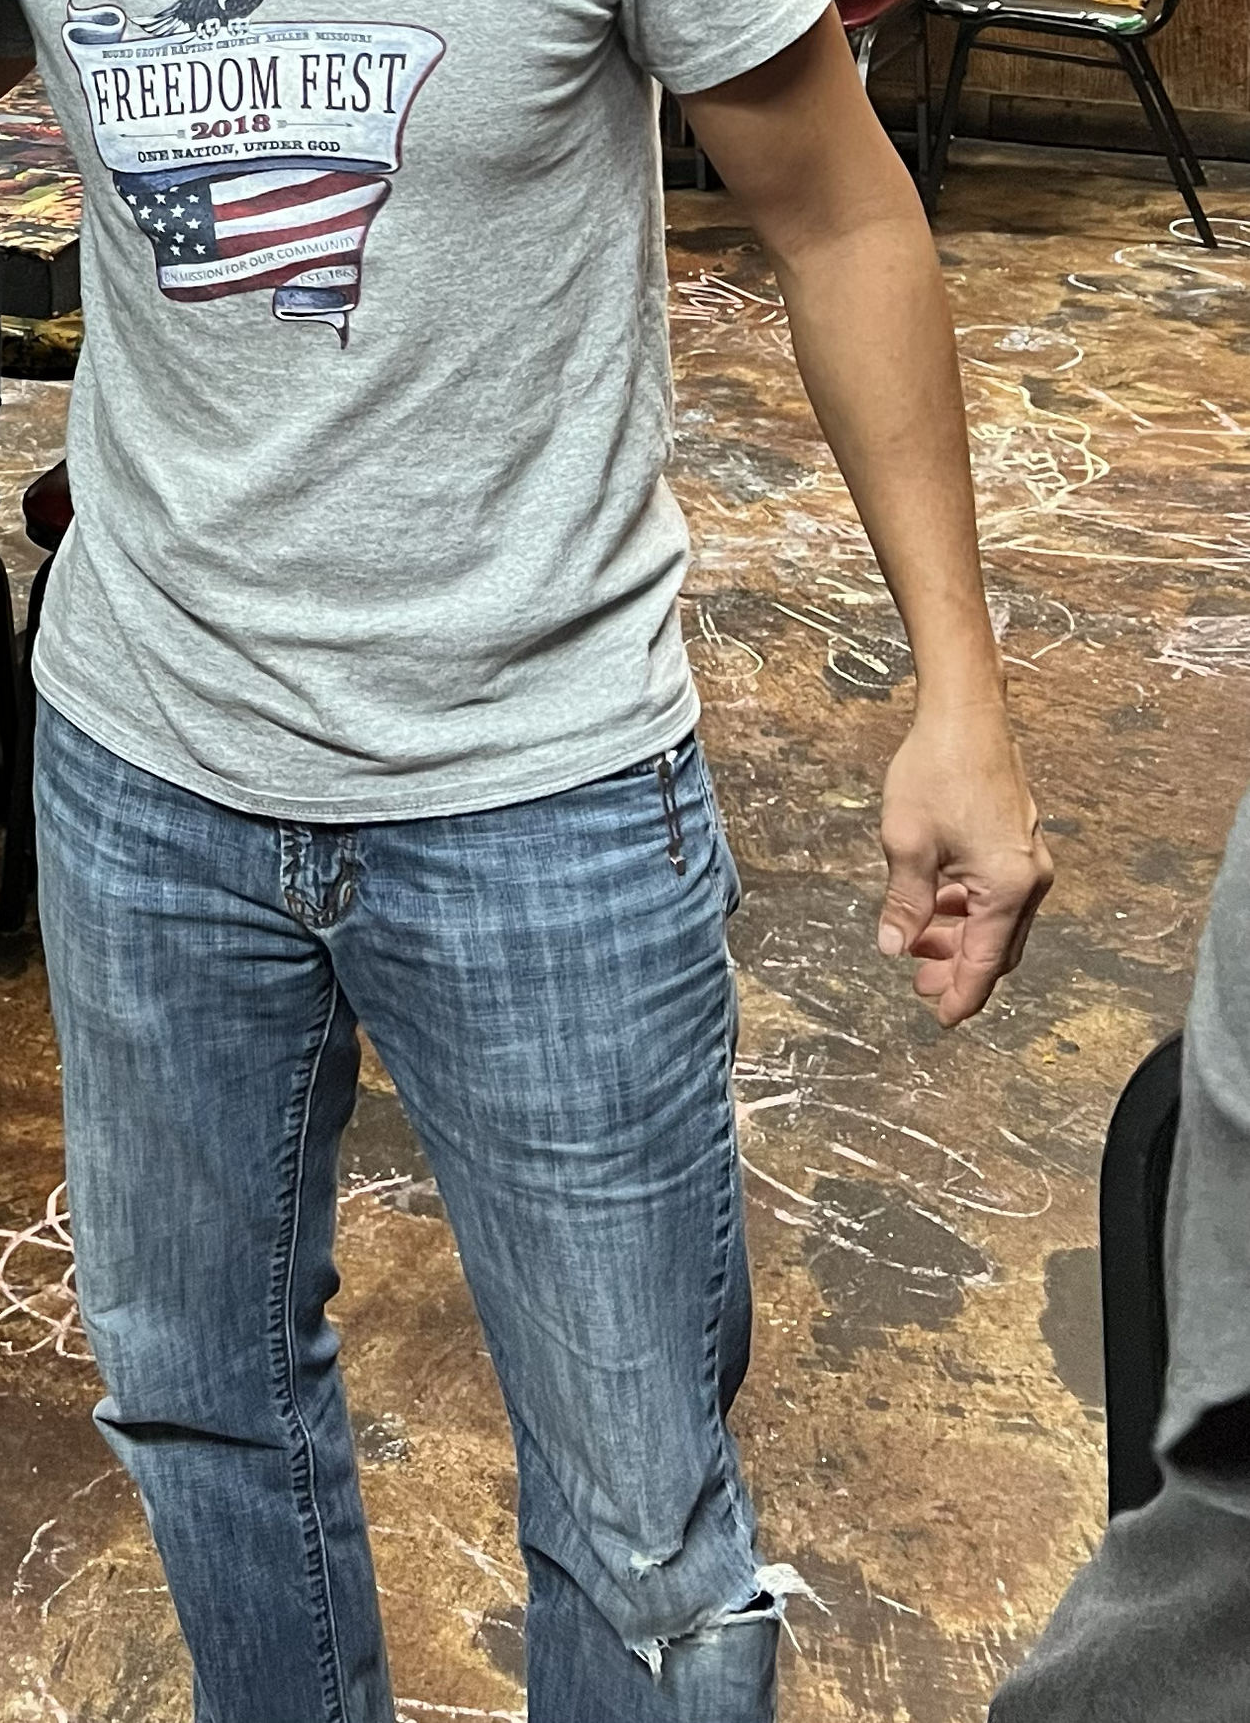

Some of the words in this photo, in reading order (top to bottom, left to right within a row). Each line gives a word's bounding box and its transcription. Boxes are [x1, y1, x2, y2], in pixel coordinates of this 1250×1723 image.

[170, 40, 215, 56] BAPTIST
[216, 35, 259, 50] CHURCH
[315, 32, 373, 45] MISSOURI
[91, 54, 282, 126] FREEDOM
[300, 53, 408, 115] FEST
[190, 113, 272, 141] 2018
[137, 146, 170, 164] ONE
[171, 142, 240, 162] NATION,
[243, 138, 304, 154] UNDER
[307, 139, 341, 155] GOD
[180, 264, 224, 282] MISSION
[224, 260, 248, 277] FOR
[248, 250, 275, 270] OUR
[276, 235, 358, 265] COMMUNITY
